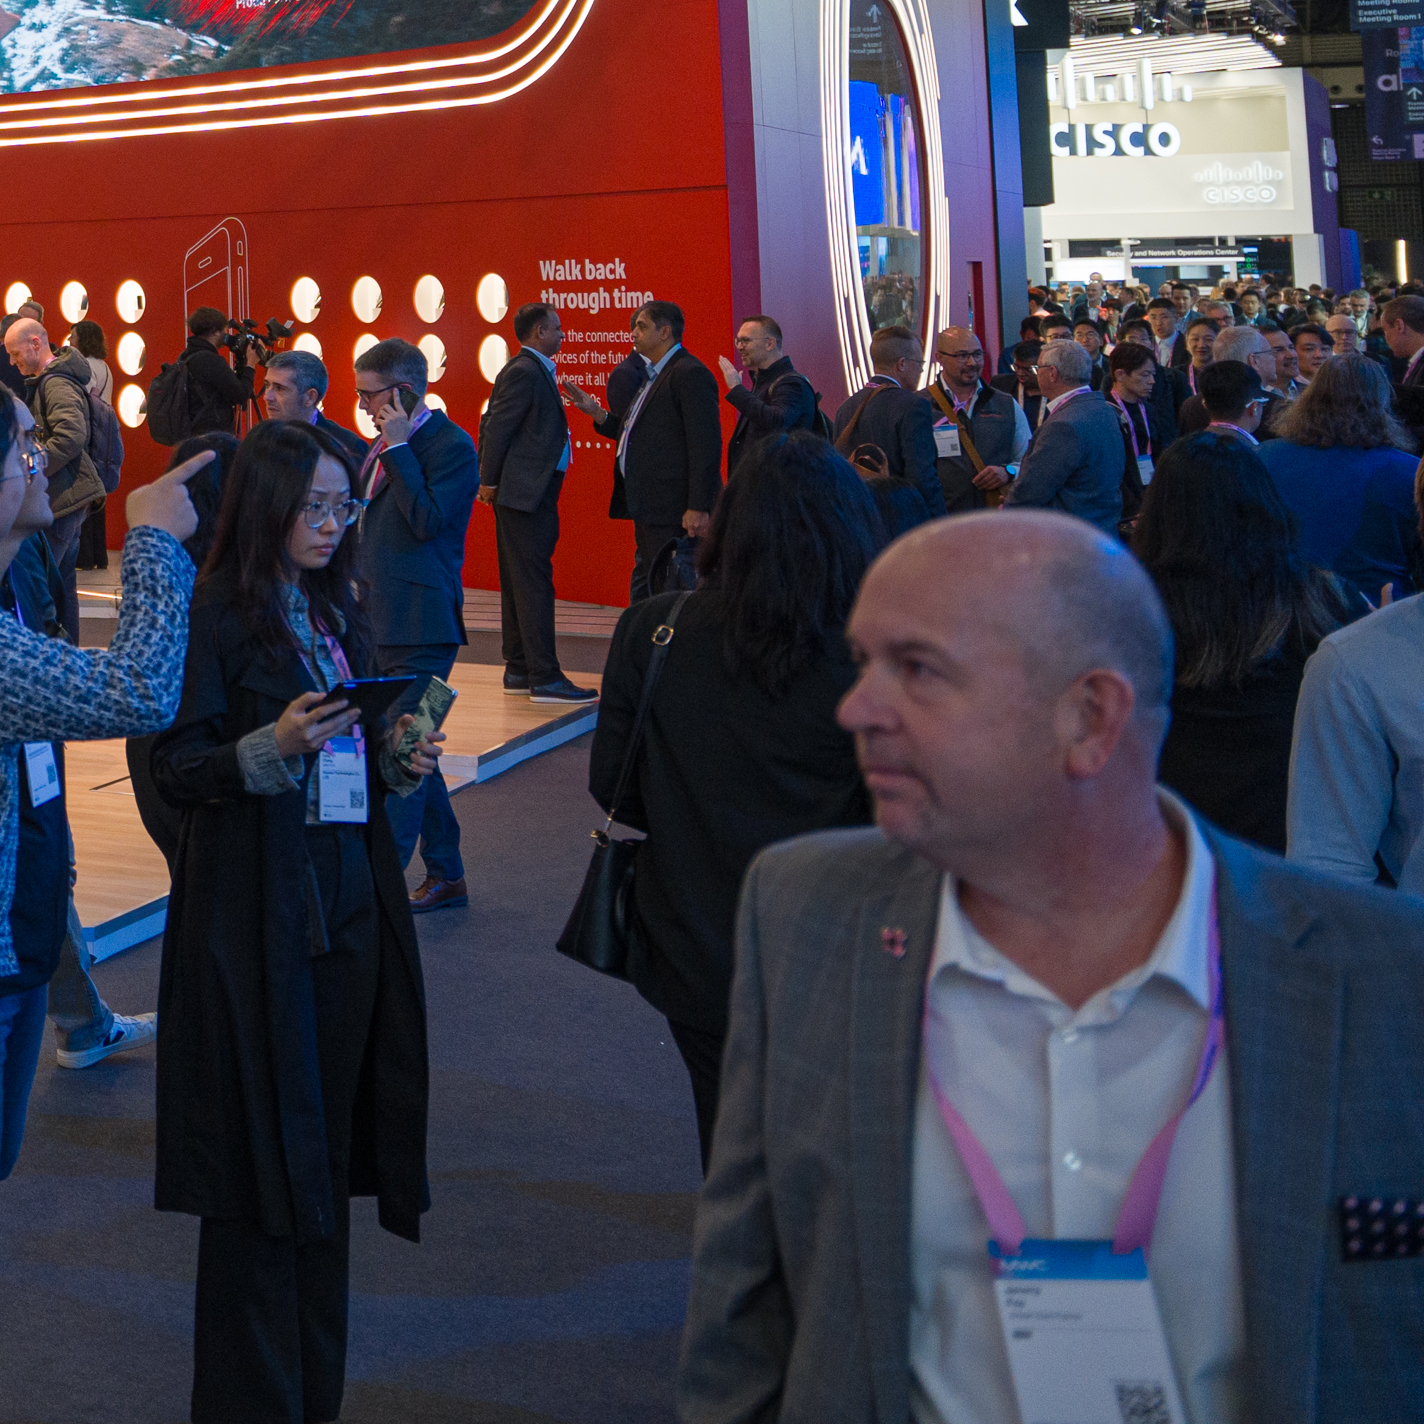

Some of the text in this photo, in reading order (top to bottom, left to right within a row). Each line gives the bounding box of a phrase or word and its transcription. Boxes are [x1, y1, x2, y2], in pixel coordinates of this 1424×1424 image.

[1357, 0, 1391, 7] Meeting
[1359, 16, 1392, 24] Meeting
[1050, 121, 1182, 158] CISCO
[1203, 185, 1277, 204] CISCO
[1148, 249, 1176, 257] Network
[1177, 249, 1214, 258] Operations
[1215, 248, 1239, 256] Center
[539, 258, 627, 281] Walk back
[540, 286, 654, 314] through time
[568, 329, 583, 342] the
[579, 351, 589, 364] of
[591, 351, 606, 364] the
[585, 372, 593, 386] it
[594, 372, 606, 386] all
